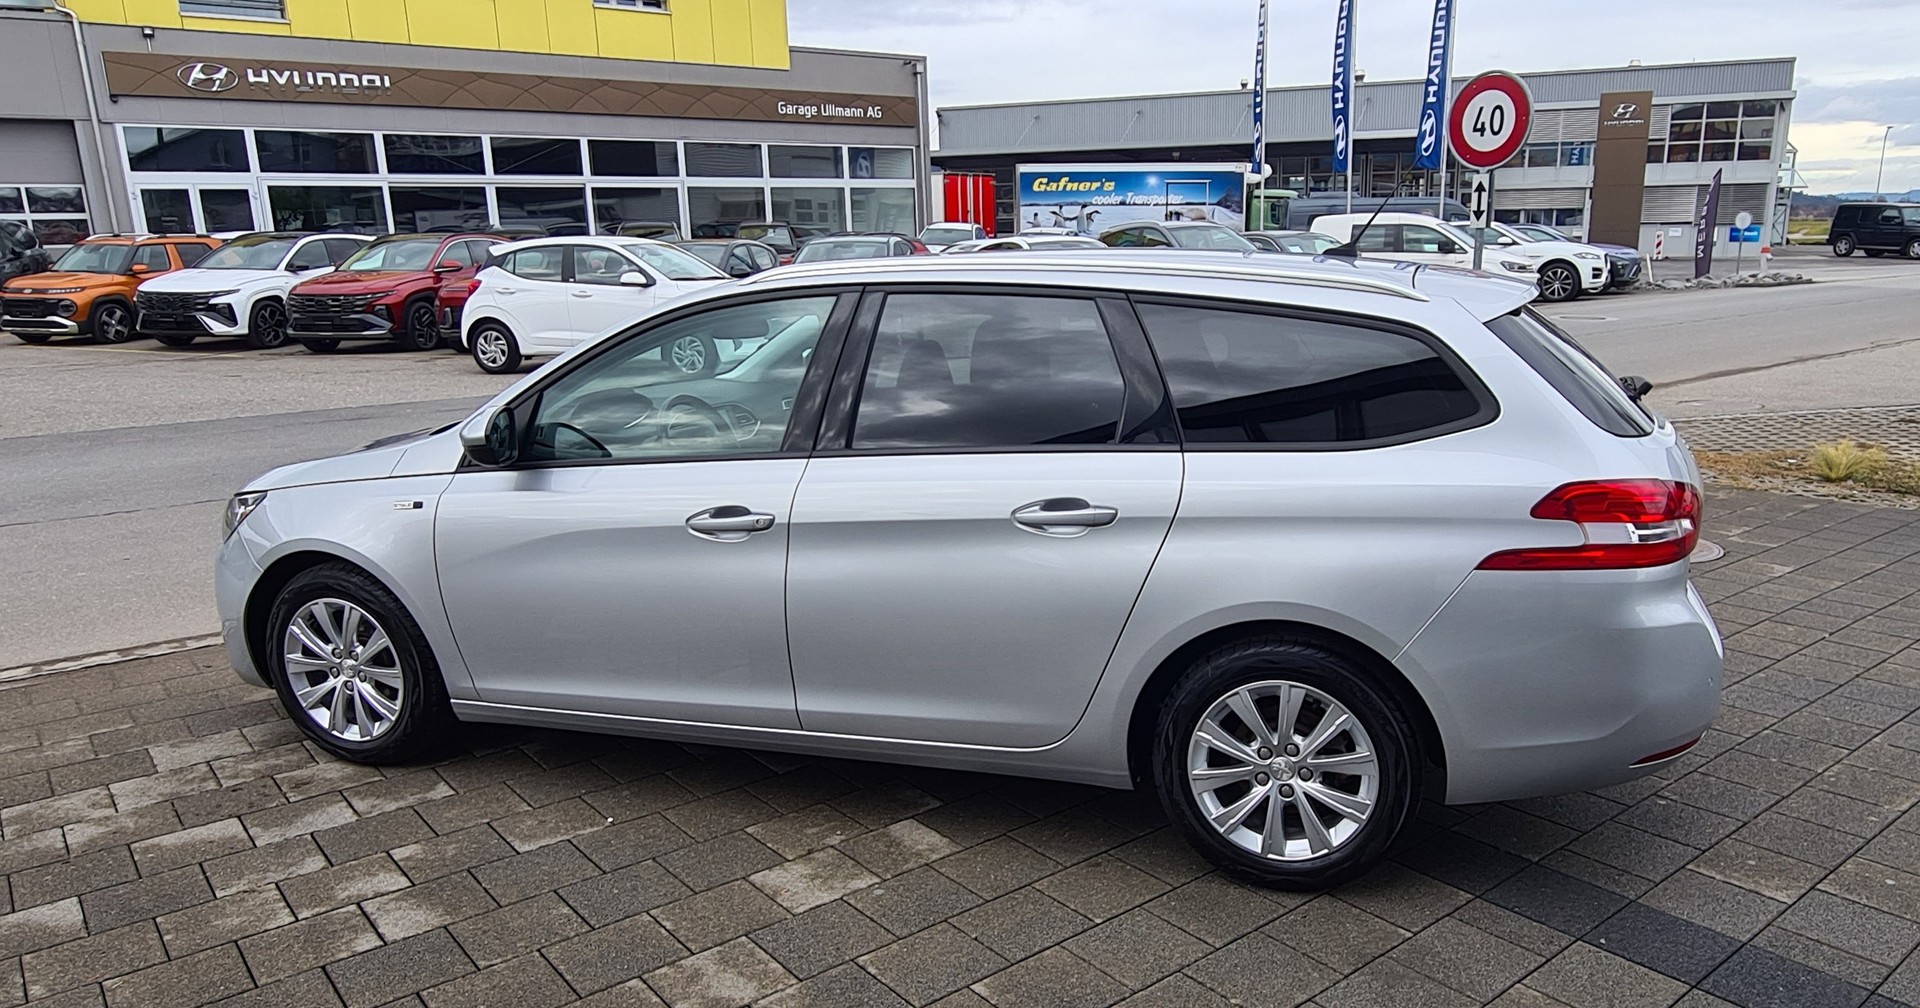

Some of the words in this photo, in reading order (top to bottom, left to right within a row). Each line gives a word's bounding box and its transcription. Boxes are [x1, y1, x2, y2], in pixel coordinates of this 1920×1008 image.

[246, 68, 392, 96] HYUNDAI
[777, 101, 818, 118] Garage
[821, 104, 864, 118] Ullmann
[866, 106, 882, 118] AG
[1472, 104, 1505, 137] 40
[1032, 177, 1115, 192] Gafner's
[1092, 192, 1123, 205] cooler
